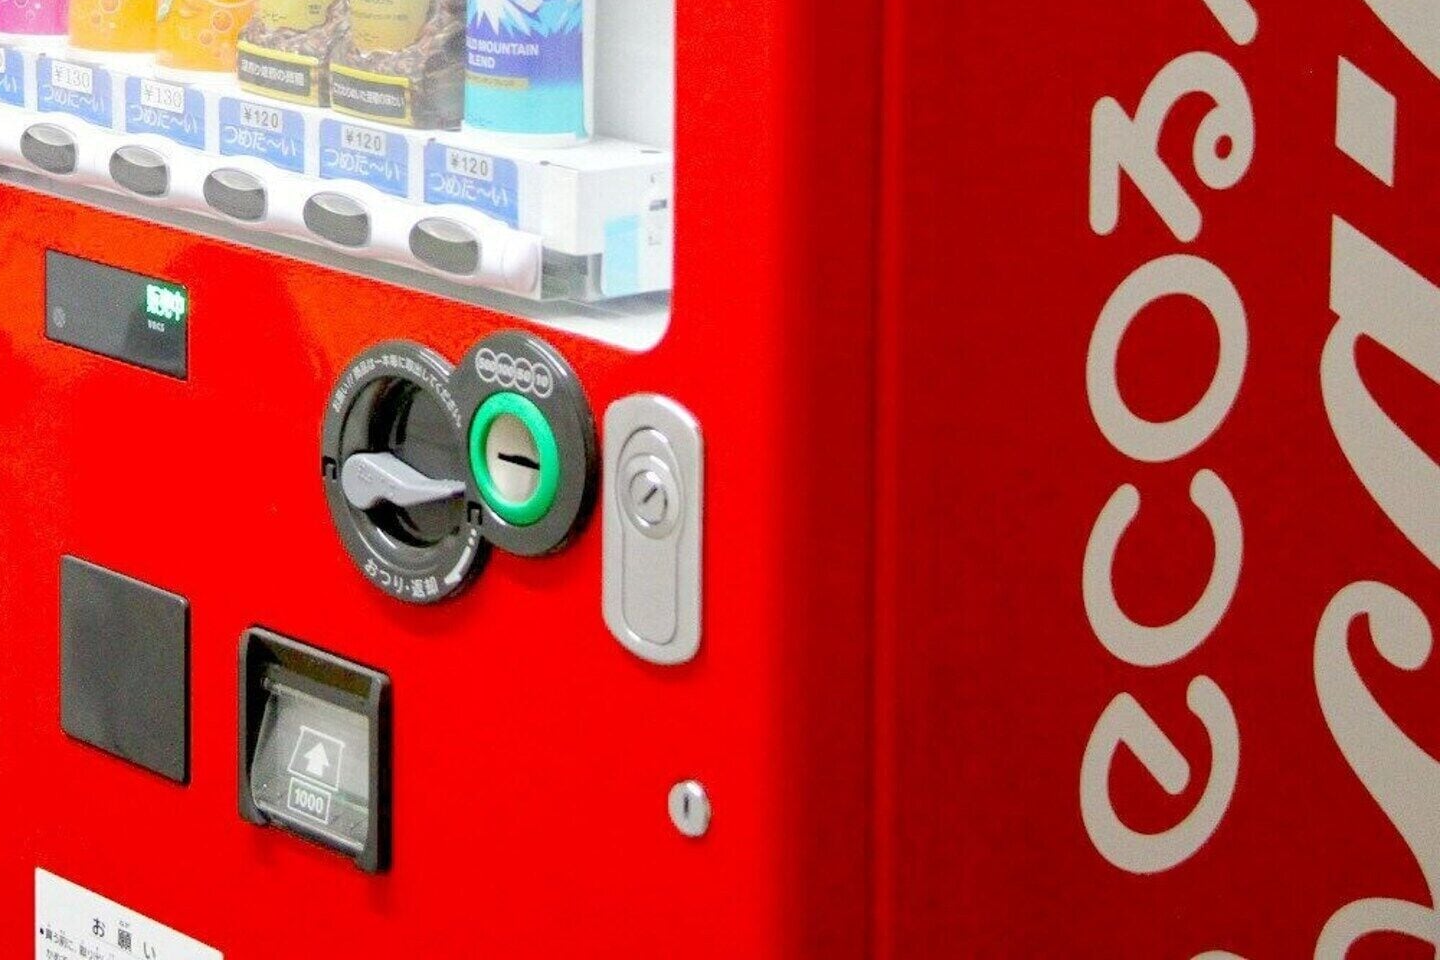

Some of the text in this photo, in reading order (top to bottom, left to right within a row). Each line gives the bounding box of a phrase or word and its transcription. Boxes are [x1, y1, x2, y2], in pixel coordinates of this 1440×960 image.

[243, 107, 279, 129] ¥120
[345, 128, 382, 152] ¥120
[450, 152, 489, 177] ¥120
[294, 788, 324, 814] 1000
